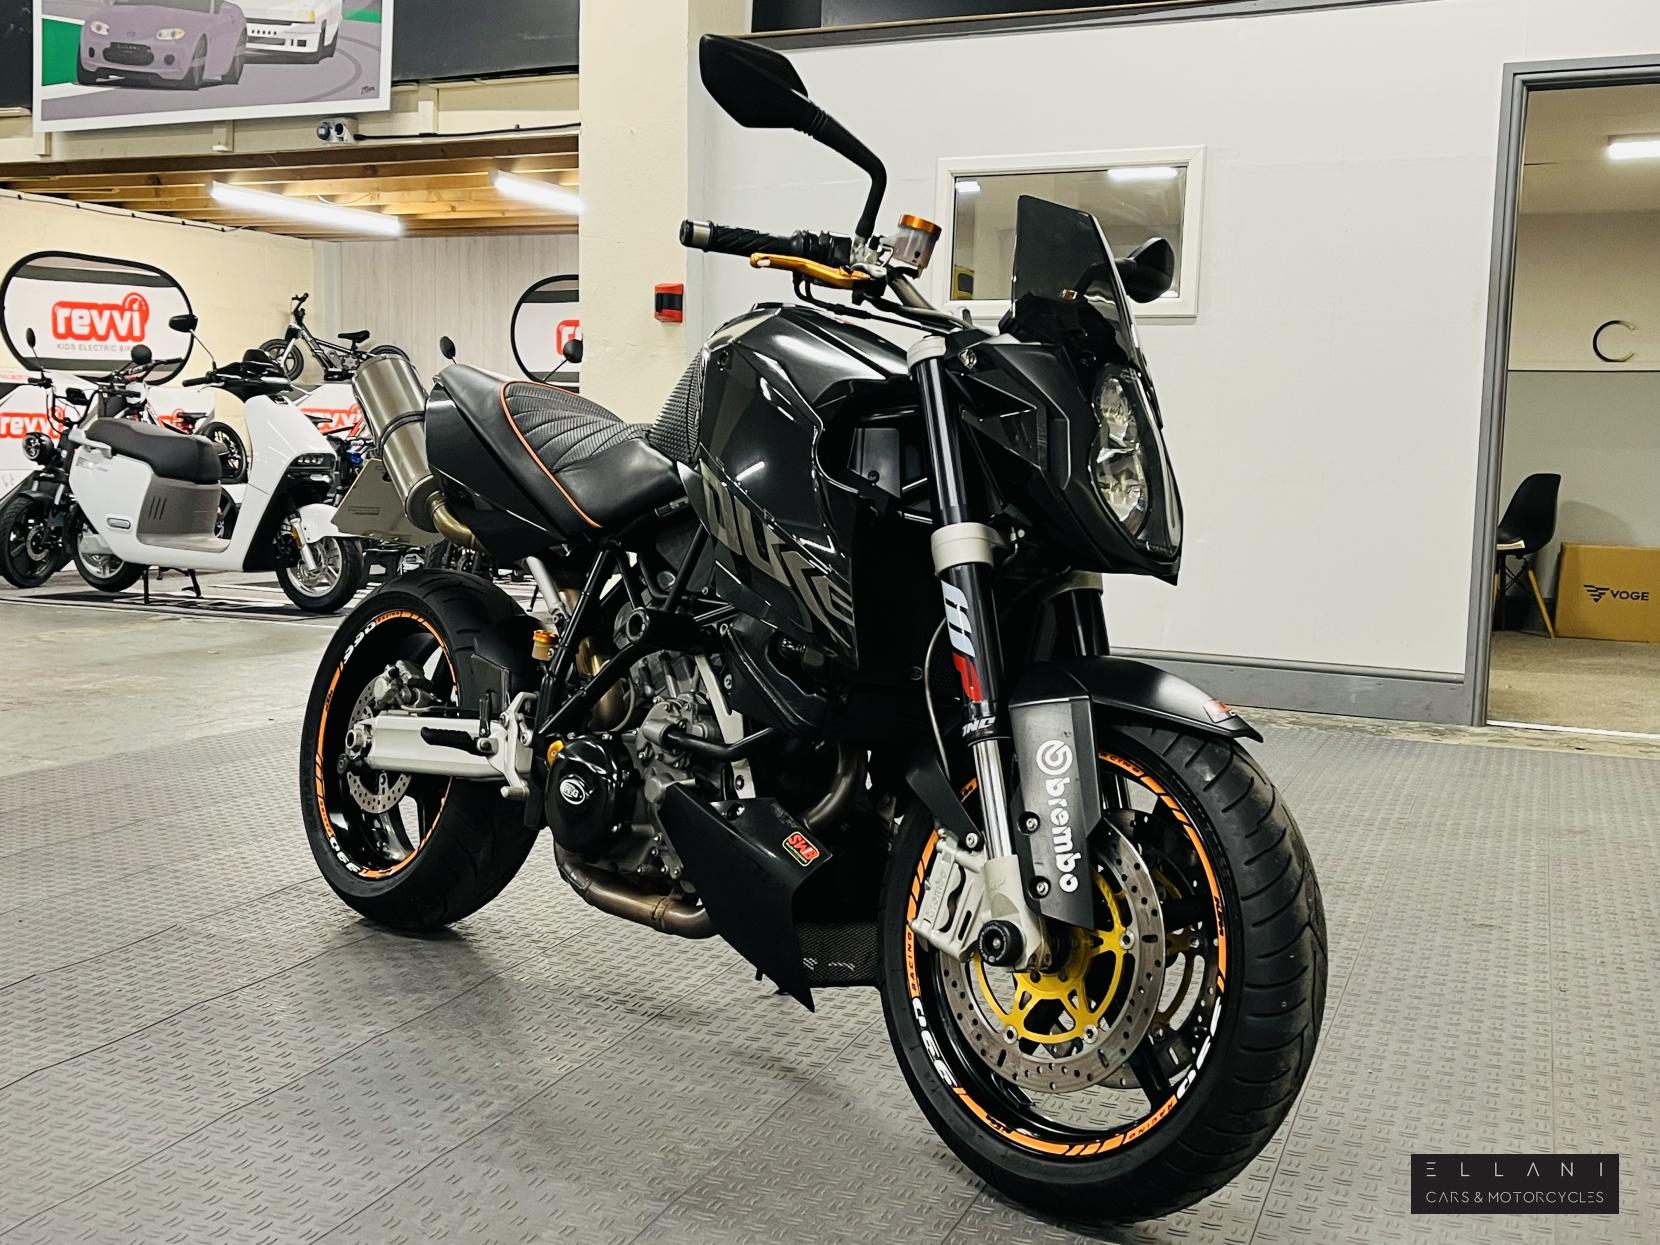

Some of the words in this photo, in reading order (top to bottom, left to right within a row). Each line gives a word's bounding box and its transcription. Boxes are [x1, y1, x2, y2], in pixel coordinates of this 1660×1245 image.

[54, 297, 147, 339] revvi
[56, 343, 77, 351] KIDS
[78, 343, 117, 353] ELECTRIC
[1610, 590, 1650, 602] VOGE
[1045, 777, 1082, 893] brembo
[906, 931, 918, 993] RACING
